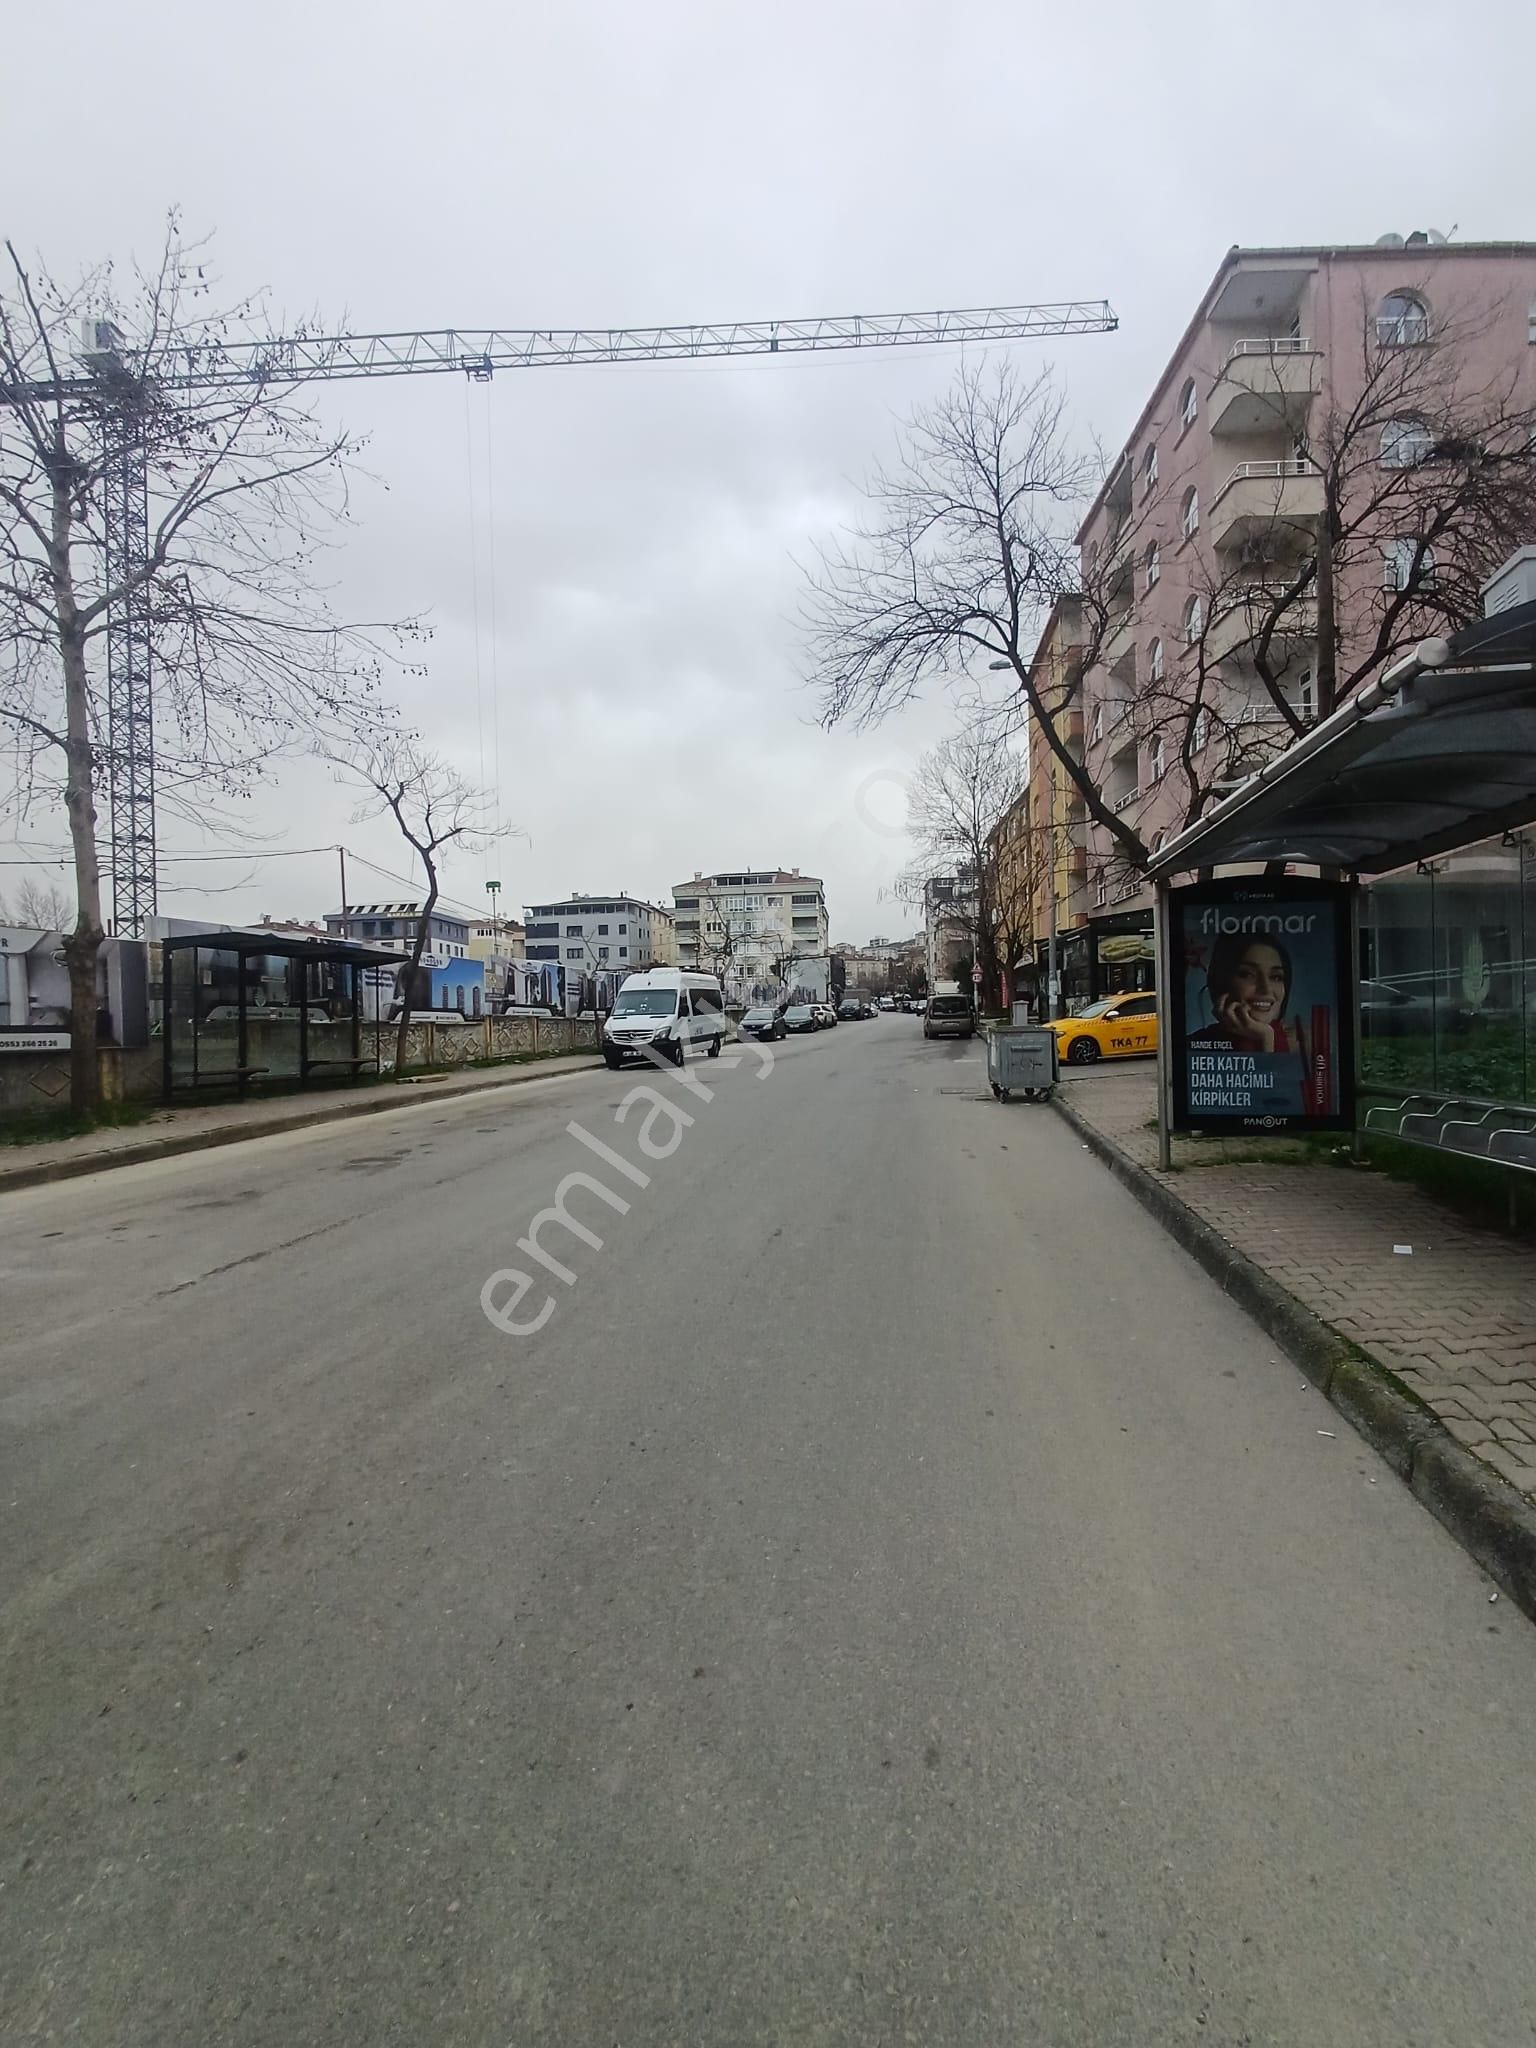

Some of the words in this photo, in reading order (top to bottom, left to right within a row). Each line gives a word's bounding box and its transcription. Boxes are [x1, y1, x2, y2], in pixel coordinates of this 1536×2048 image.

[1200, 908, 1317, 934] flormar
[1110, 1038, 1133, 1048] TKA
[1135, 1036, 1148, 1046] 77
[1191, 1041, 1213, 1049] HANDE
[1191, 1056, 1216, 1071] HER
[1217, 1056, 1255, 1071] KATTA
[1191, 1073, 1223, 1088] DAHA
[1226, 1071, 1274, 1088] HACİMLİ
[1191, 1089, 1251, 1107] KİRPİKLER
